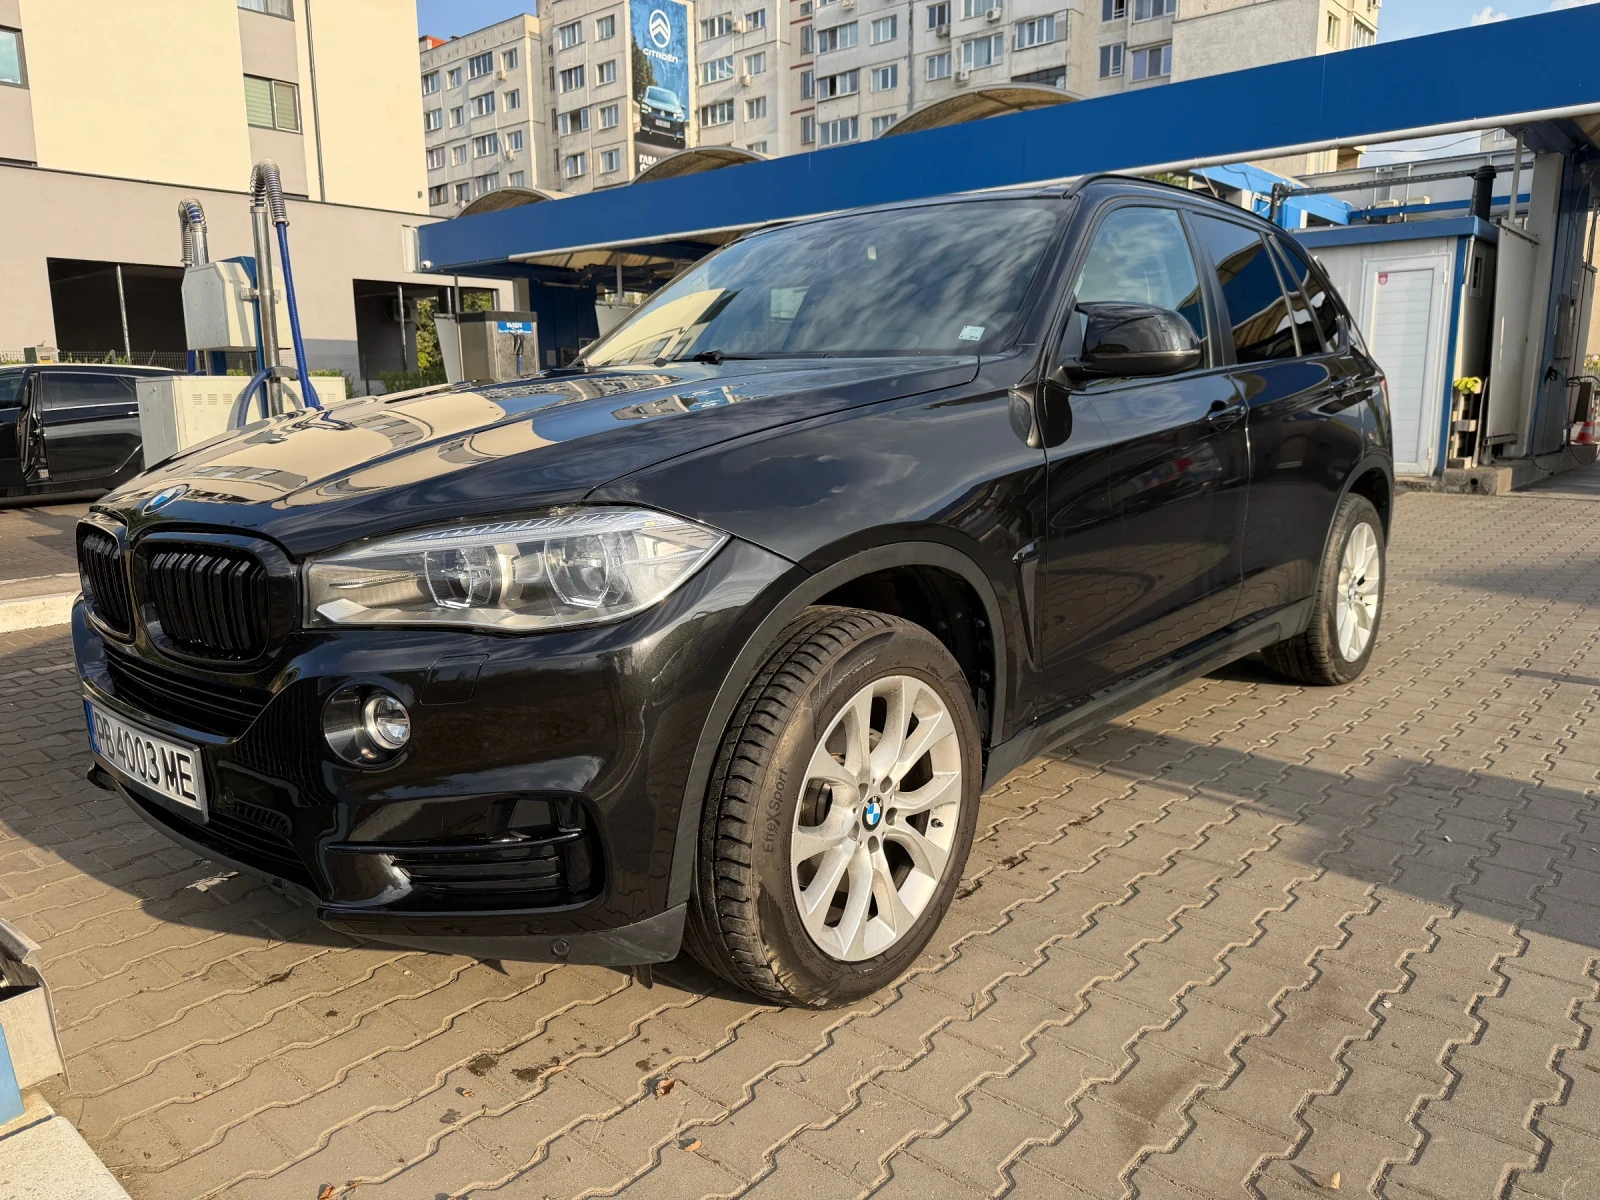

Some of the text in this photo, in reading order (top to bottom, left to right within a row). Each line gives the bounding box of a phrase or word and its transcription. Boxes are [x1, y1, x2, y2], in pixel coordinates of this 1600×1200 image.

[94, 711, 198, 802] PB 4003 ME
